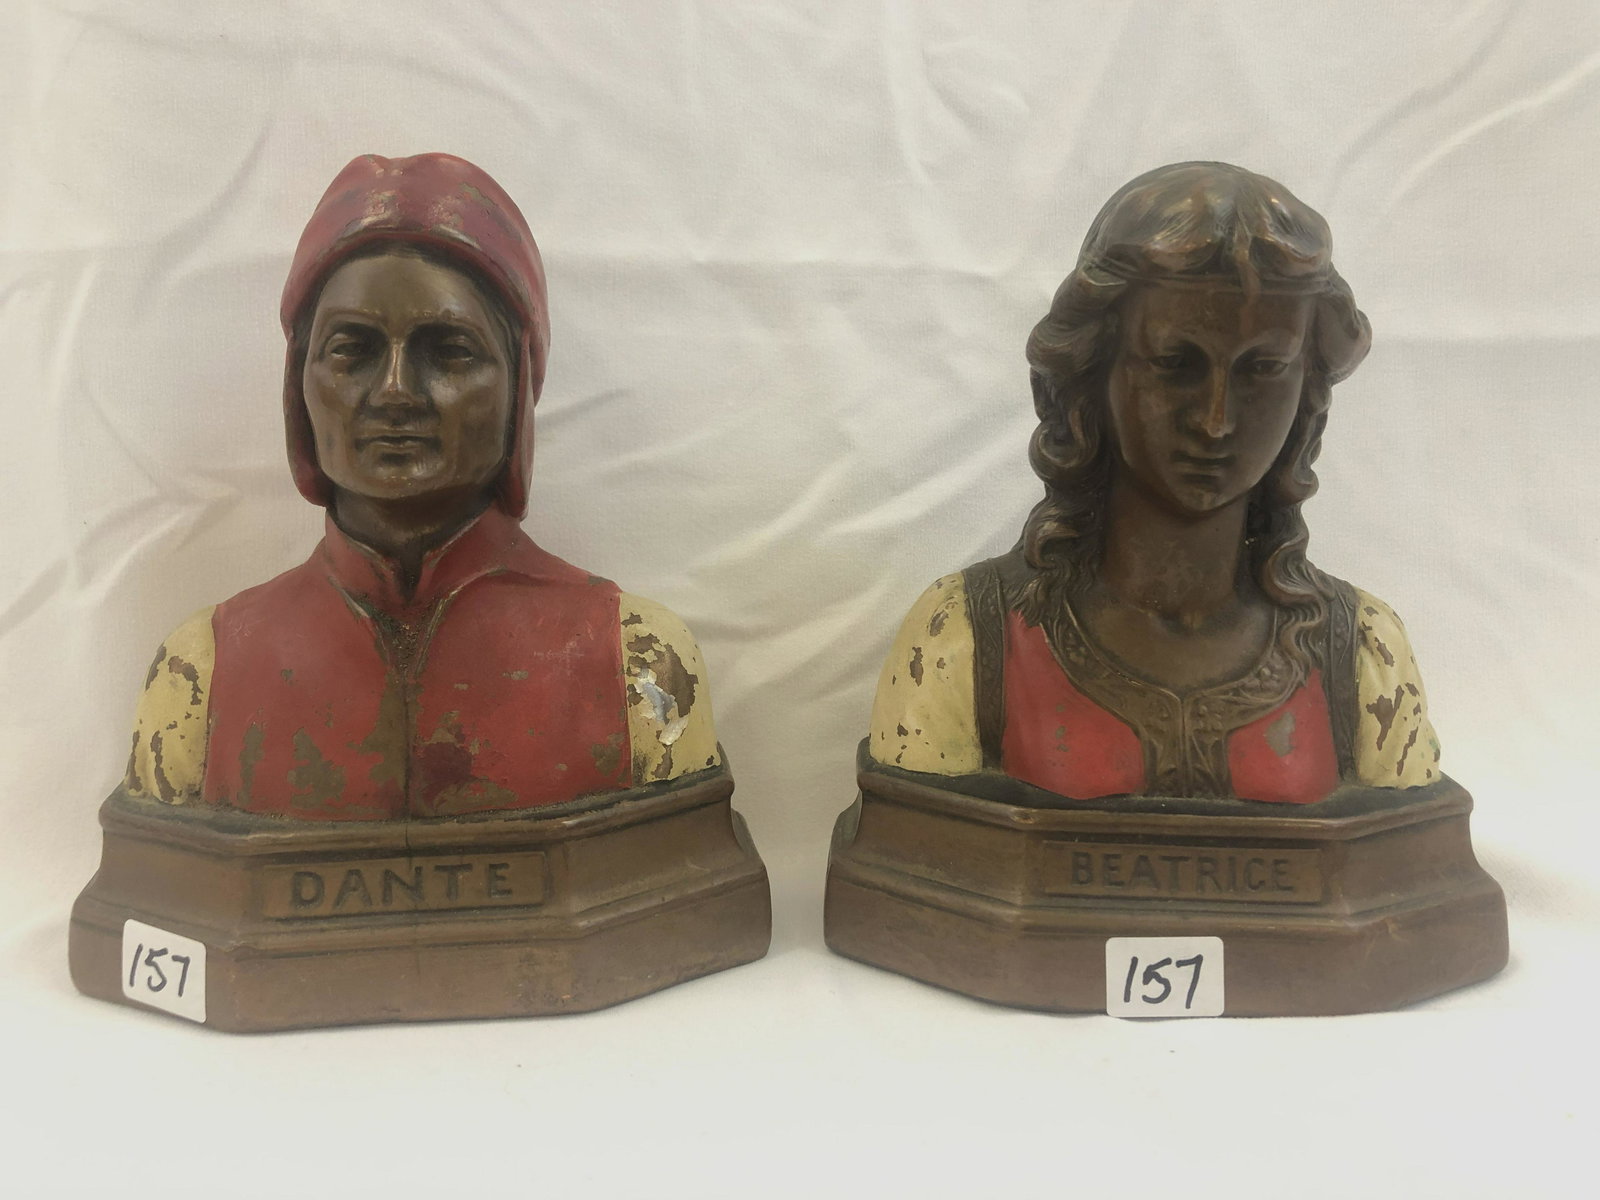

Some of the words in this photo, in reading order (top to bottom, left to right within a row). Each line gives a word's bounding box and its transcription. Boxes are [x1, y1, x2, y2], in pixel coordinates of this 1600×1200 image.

[290, 862, 513, 908] DANTE
[1071, 851, 1294, 892] BEATRICE
[129, 943, 191, 998] 157
[1123, 953, 1204, 1010] 157
